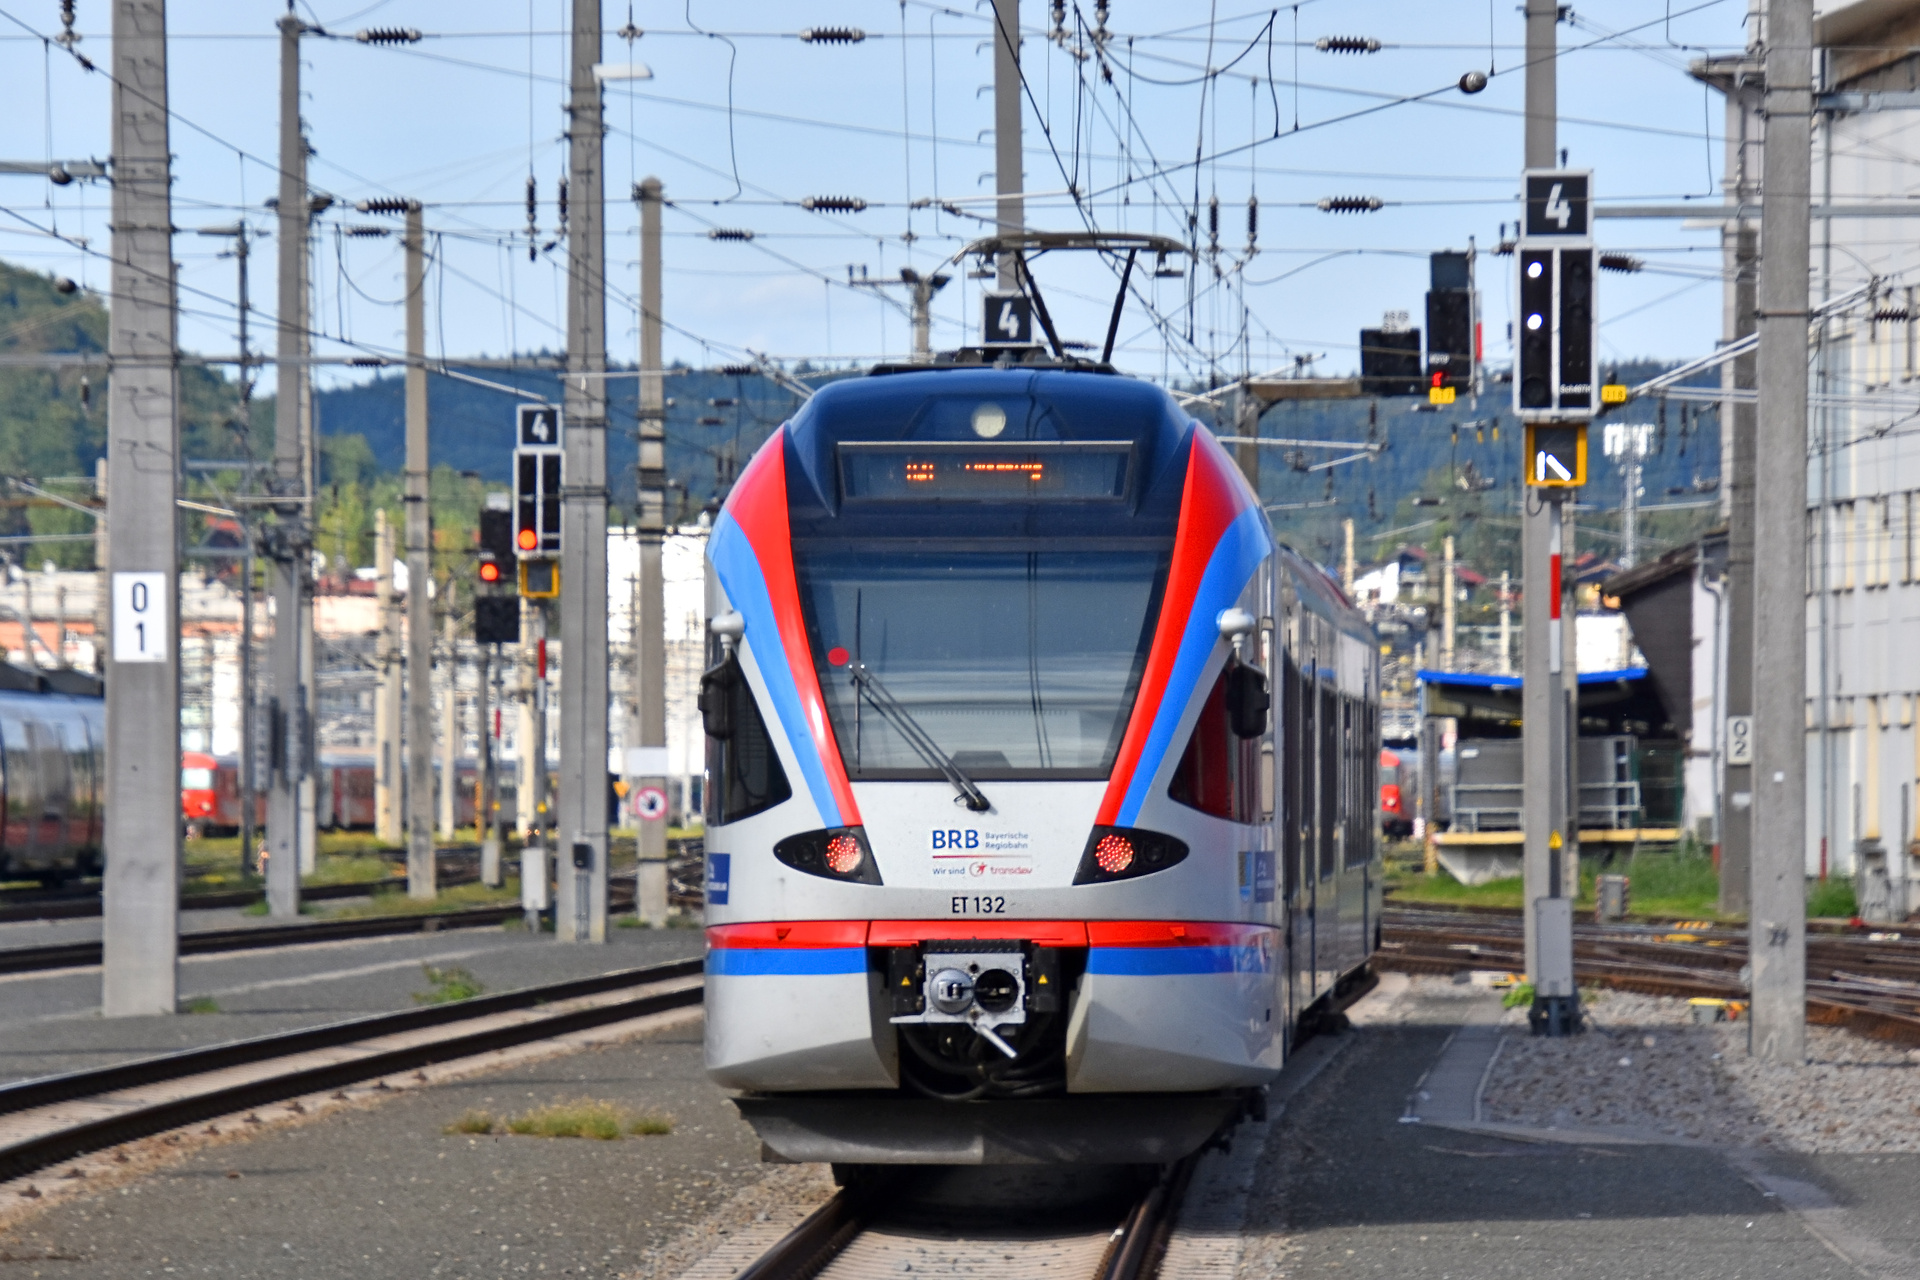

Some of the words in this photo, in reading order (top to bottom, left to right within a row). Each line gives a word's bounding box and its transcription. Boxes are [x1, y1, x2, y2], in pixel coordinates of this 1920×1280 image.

[1545, 183, 1571, 229] 4
[998, 301, 1020, 338] 4
[531, 413, 549, 442] 4
[932, 829, 979, 849] BRB
[985, 832, 1028, 840] Bayerische
[985, 842, 1028, 850] Regiobahn
[948, 867, 965, 875] sind
[990, 867, 1032, 875] transdev
[951, 896, 968, 913] ET
[974, 896, 1005, 913] 132
